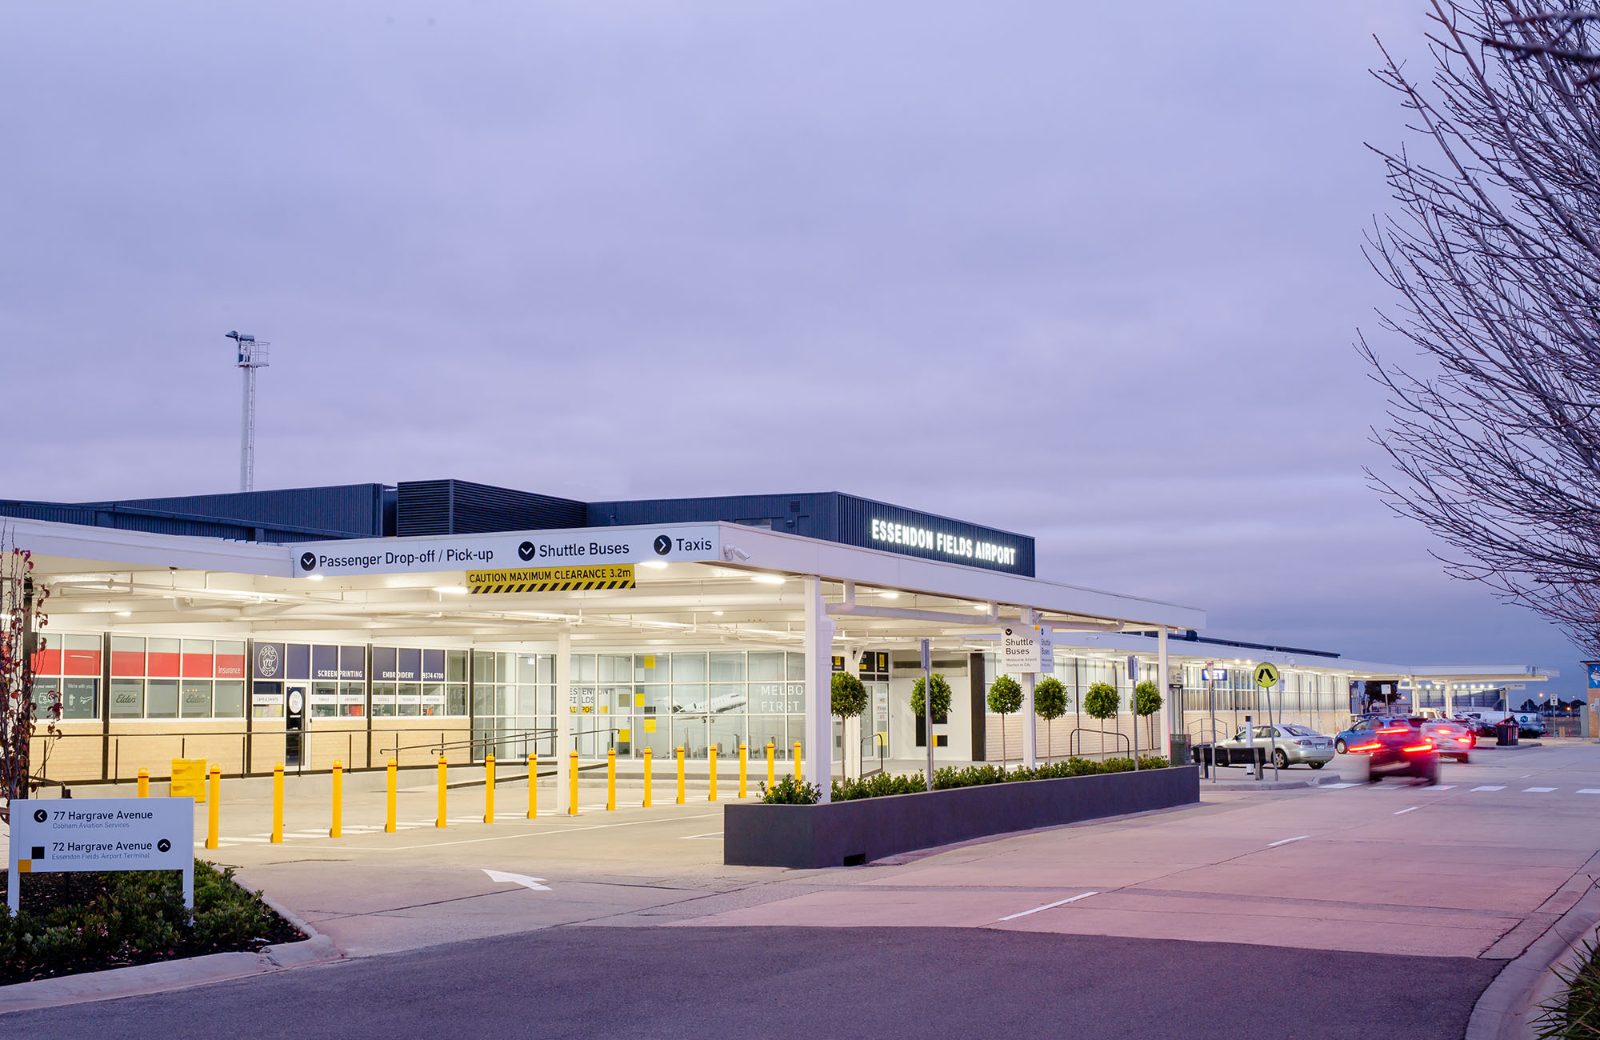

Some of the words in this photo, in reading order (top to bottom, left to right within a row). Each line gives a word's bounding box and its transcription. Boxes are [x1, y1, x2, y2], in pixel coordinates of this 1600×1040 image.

[676, 537, 712, 550] Taxis
[872, 519, 934, 550] ESSENDON
[937, 532, 973, 558] FIELDS
[975, 541, 1016, 565] AIRPORT
[539, 543, 585, 557] Shuttle
[590, 542, 630, 555] Buses
[320, 554, 382, 568] Passenger
[386, 549, 435, 565] Drop-off
[447, 548, 494, 563] Pick-up
[470, 573, 507, 583] CAUTION
[510, 571, 552, 581] MAXIMUM
[555, 569, 607, 579] CLEARANCE
[610, 568, 631, 578] 3.2m
[1005, 638, 1034, 646] Shuttle
[1005, 647, 1030, 655] Buses
[317, 670, 338, 678] SCREEN
[339, 670, 363, 679] PRINTING
[761, 701, 800, 712] FIRST
[54, 811, 66, 820] 77
[69, 811, 114, 822] Hargrave
[116, 810, 153, 820] Avenue
[53, 842, 65, 851] 72
[67, 842, 113, 853] Hargrave
[116, 841, 152, 851] Avenue
[101, 852, 122, 860] Airport
